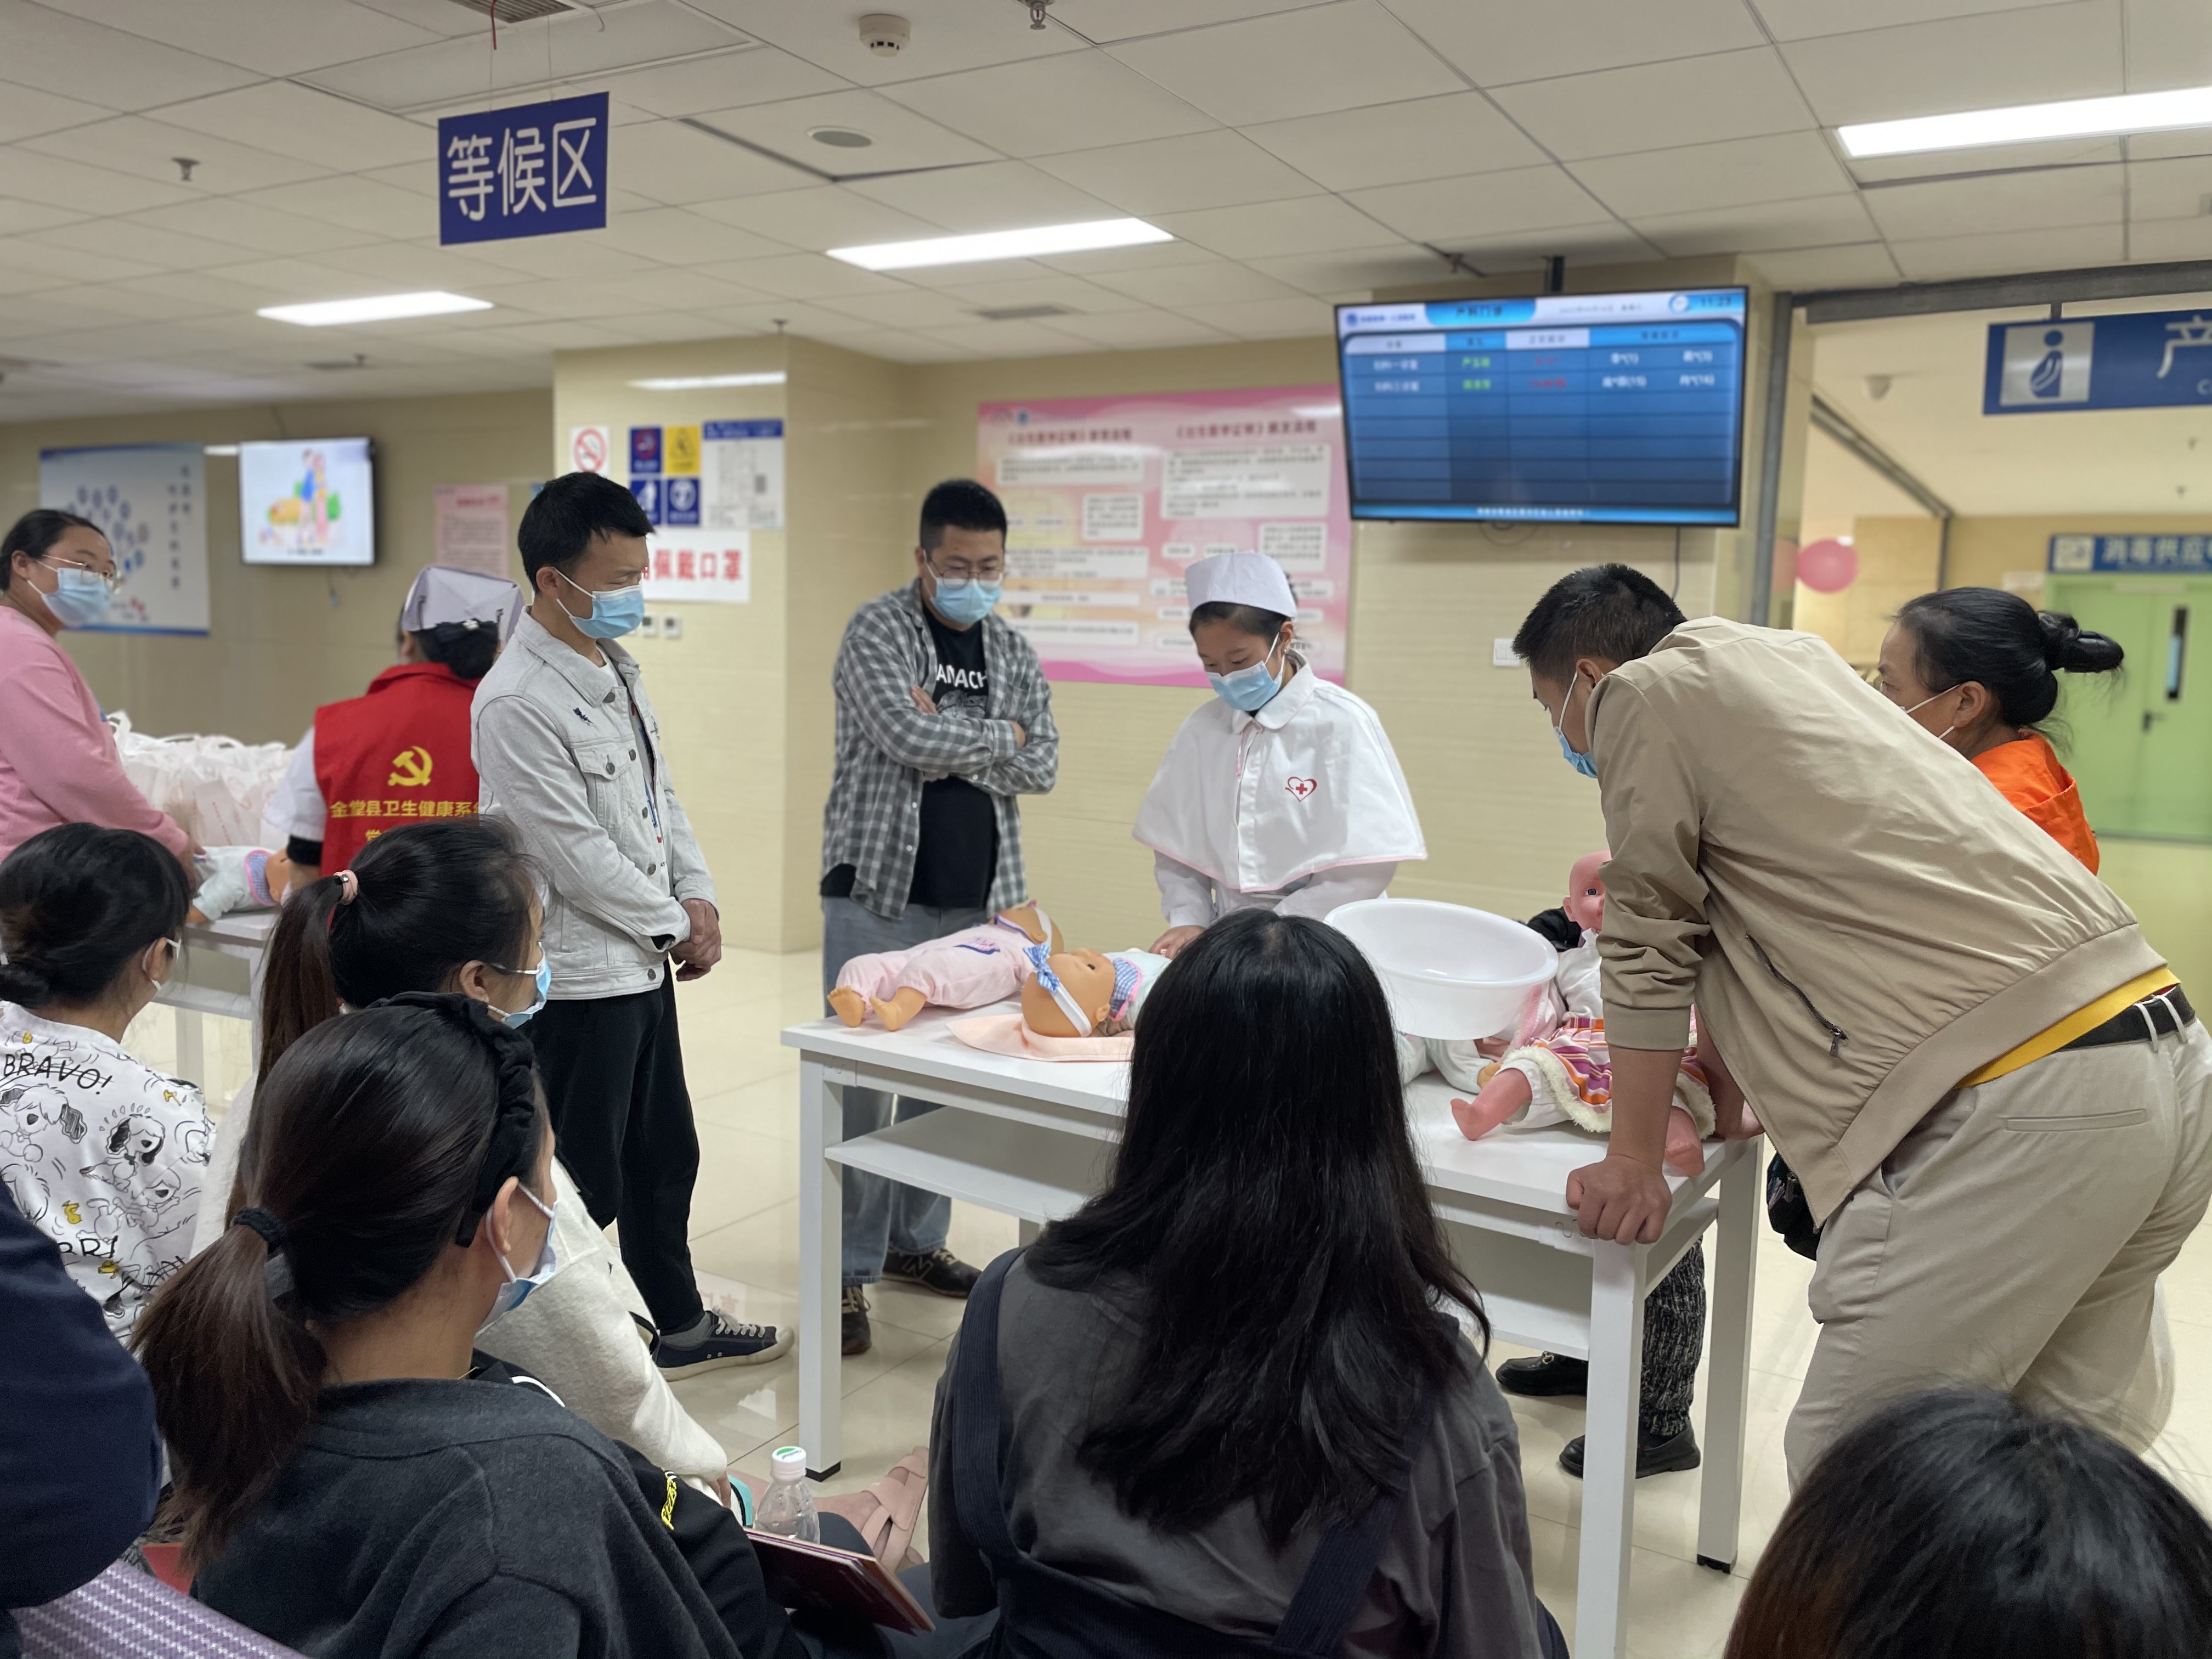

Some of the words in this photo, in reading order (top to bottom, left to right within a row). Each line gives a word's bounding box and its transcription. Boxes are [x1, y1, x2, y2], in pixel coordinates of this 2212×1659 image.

[447, 117, 597, 221] 等候区
[641, 549, 742, 582] 佩戴口罩
[2102, 536, 2212, 565] 消毒供应
[3, 1052, 113, 1095] BRAVO!
